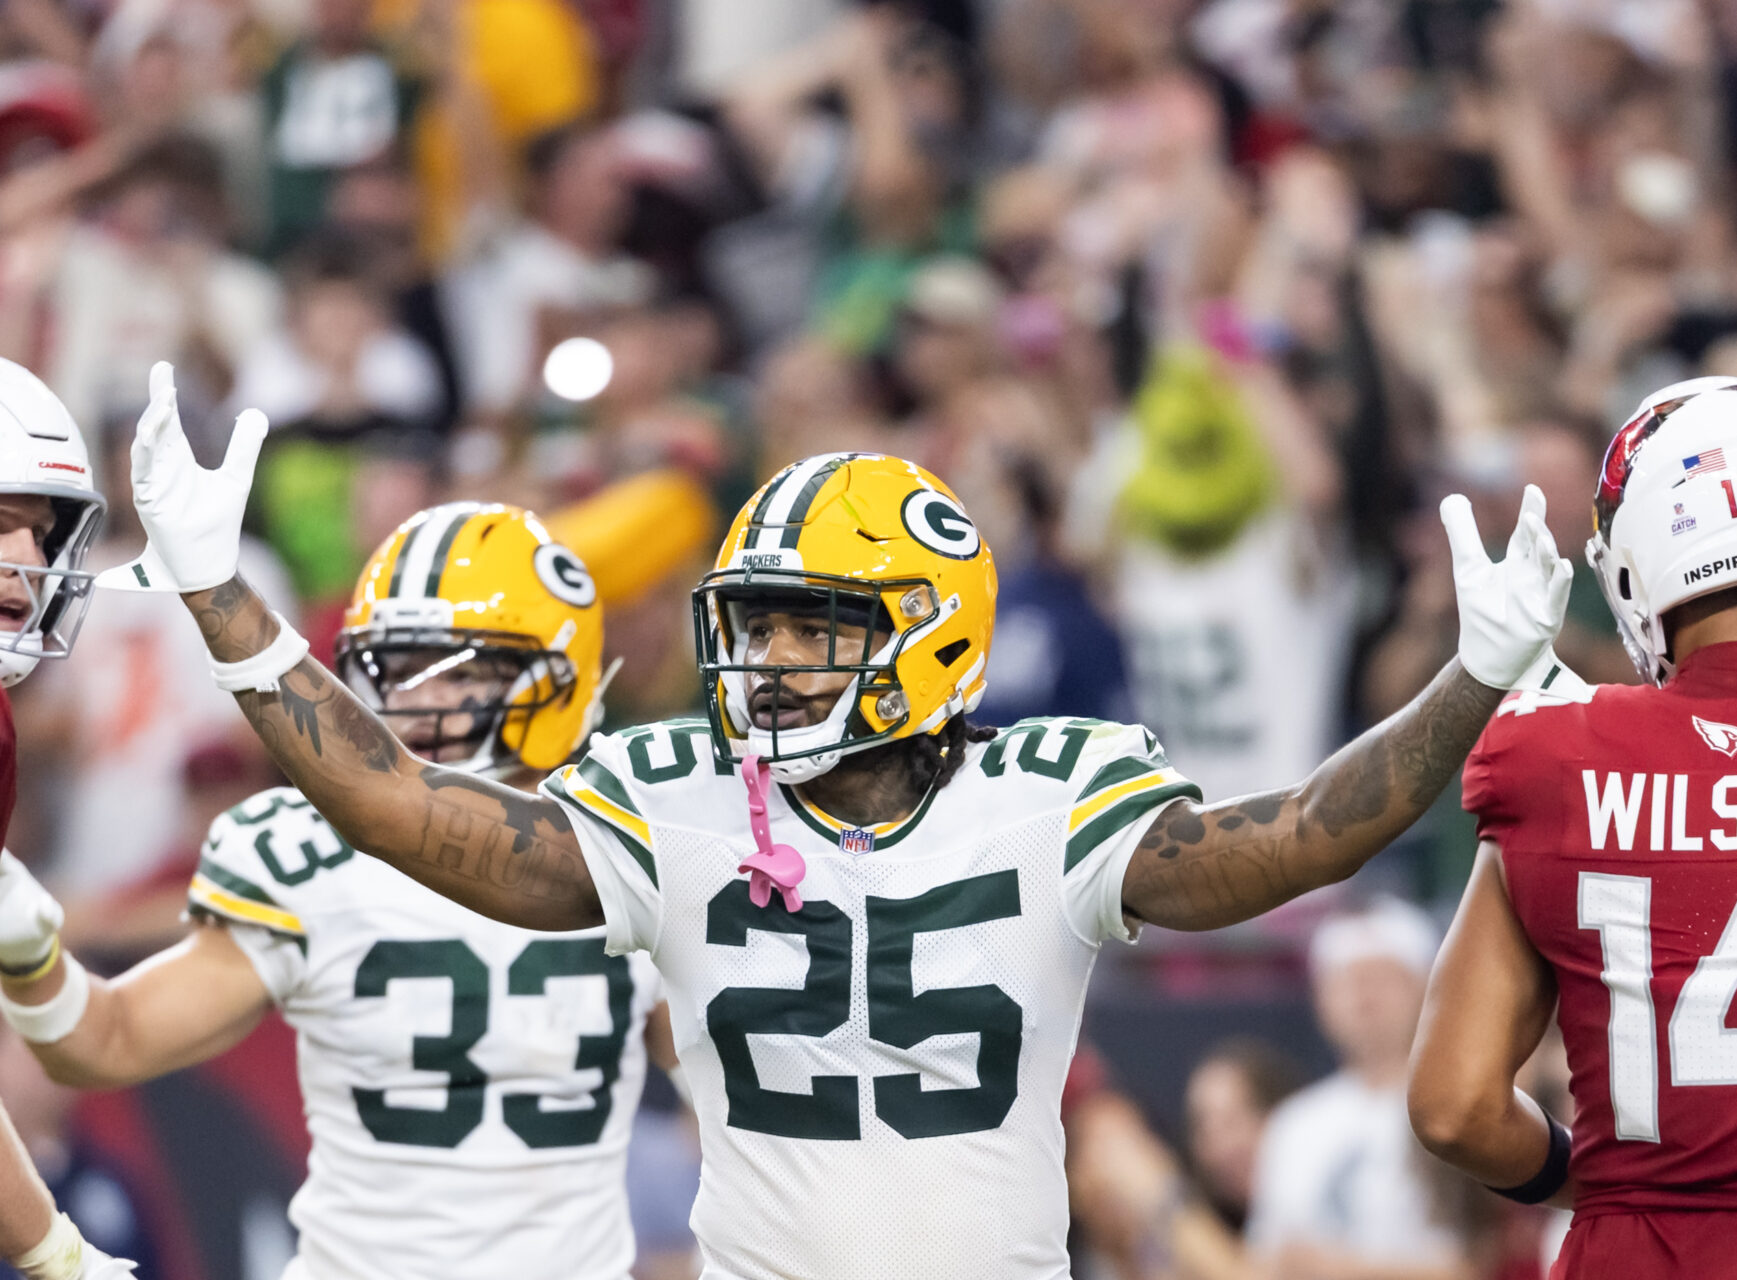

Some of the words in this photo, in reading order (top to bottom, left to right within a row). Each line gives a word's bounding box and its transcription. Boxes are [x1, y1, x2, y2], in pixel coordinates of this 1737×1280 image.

[902, 490, 980, 560] G
[1671, 517, 1697, 534] CATCH
[534, 543, 597, 609] G
[742, 554, 782, 569] PACKERS
[845, 838, 869, 853] NFL
[1582, 769, 1737, 852] WILS
[706, 868, 1023, 1140] 25
[1577, 871, 1737, 1144] 14
[352, 937, 635, 1148] 33
